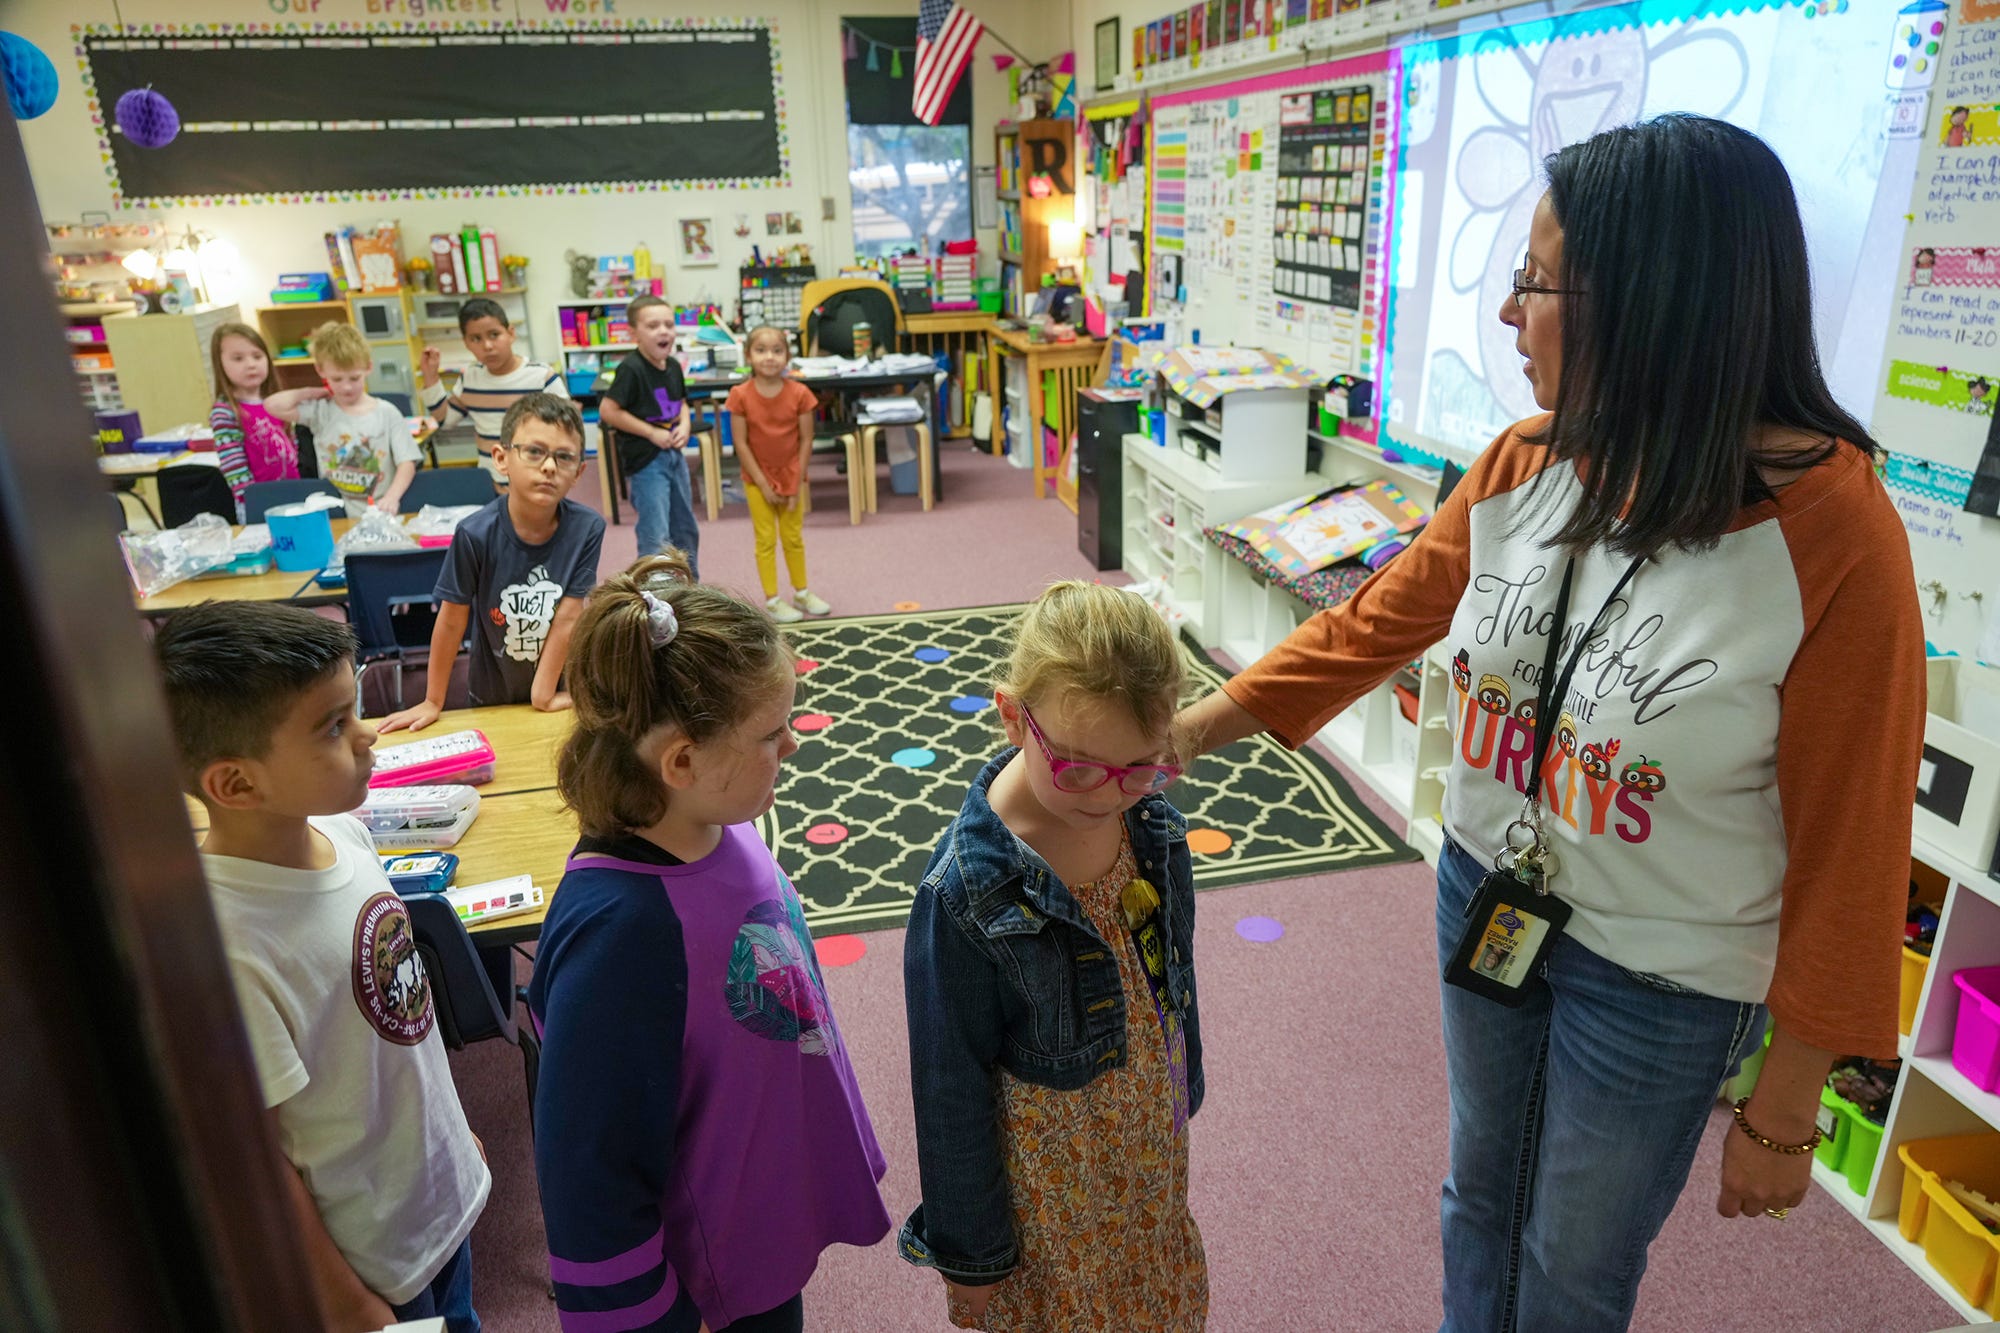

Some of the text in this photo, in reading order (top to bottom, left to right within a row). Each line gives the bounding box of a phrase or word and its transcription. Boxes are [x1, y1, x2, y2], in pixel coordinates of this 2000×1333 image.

[269, 0, 617, 17] Our Brightest Work
[1950, 46, 1994, 67] about
[1026, 138, 1076, 198] R
[1935, 155, 1951, 171] I
[1956, 157, 1985, 170] can
[682, 220, 714, 255] R
[1921, 291, 1944, 303] can
[1955, 329, 1998, 347] 11-20
[508, 590, 557, 616] JUST
[517, 618, 541, 635] DO
[513, 636, 546, 655] IT
[1474, 565, 1719, 726] Thankful
[362, 900, 391, 994] LEVI'S PREMIUM
